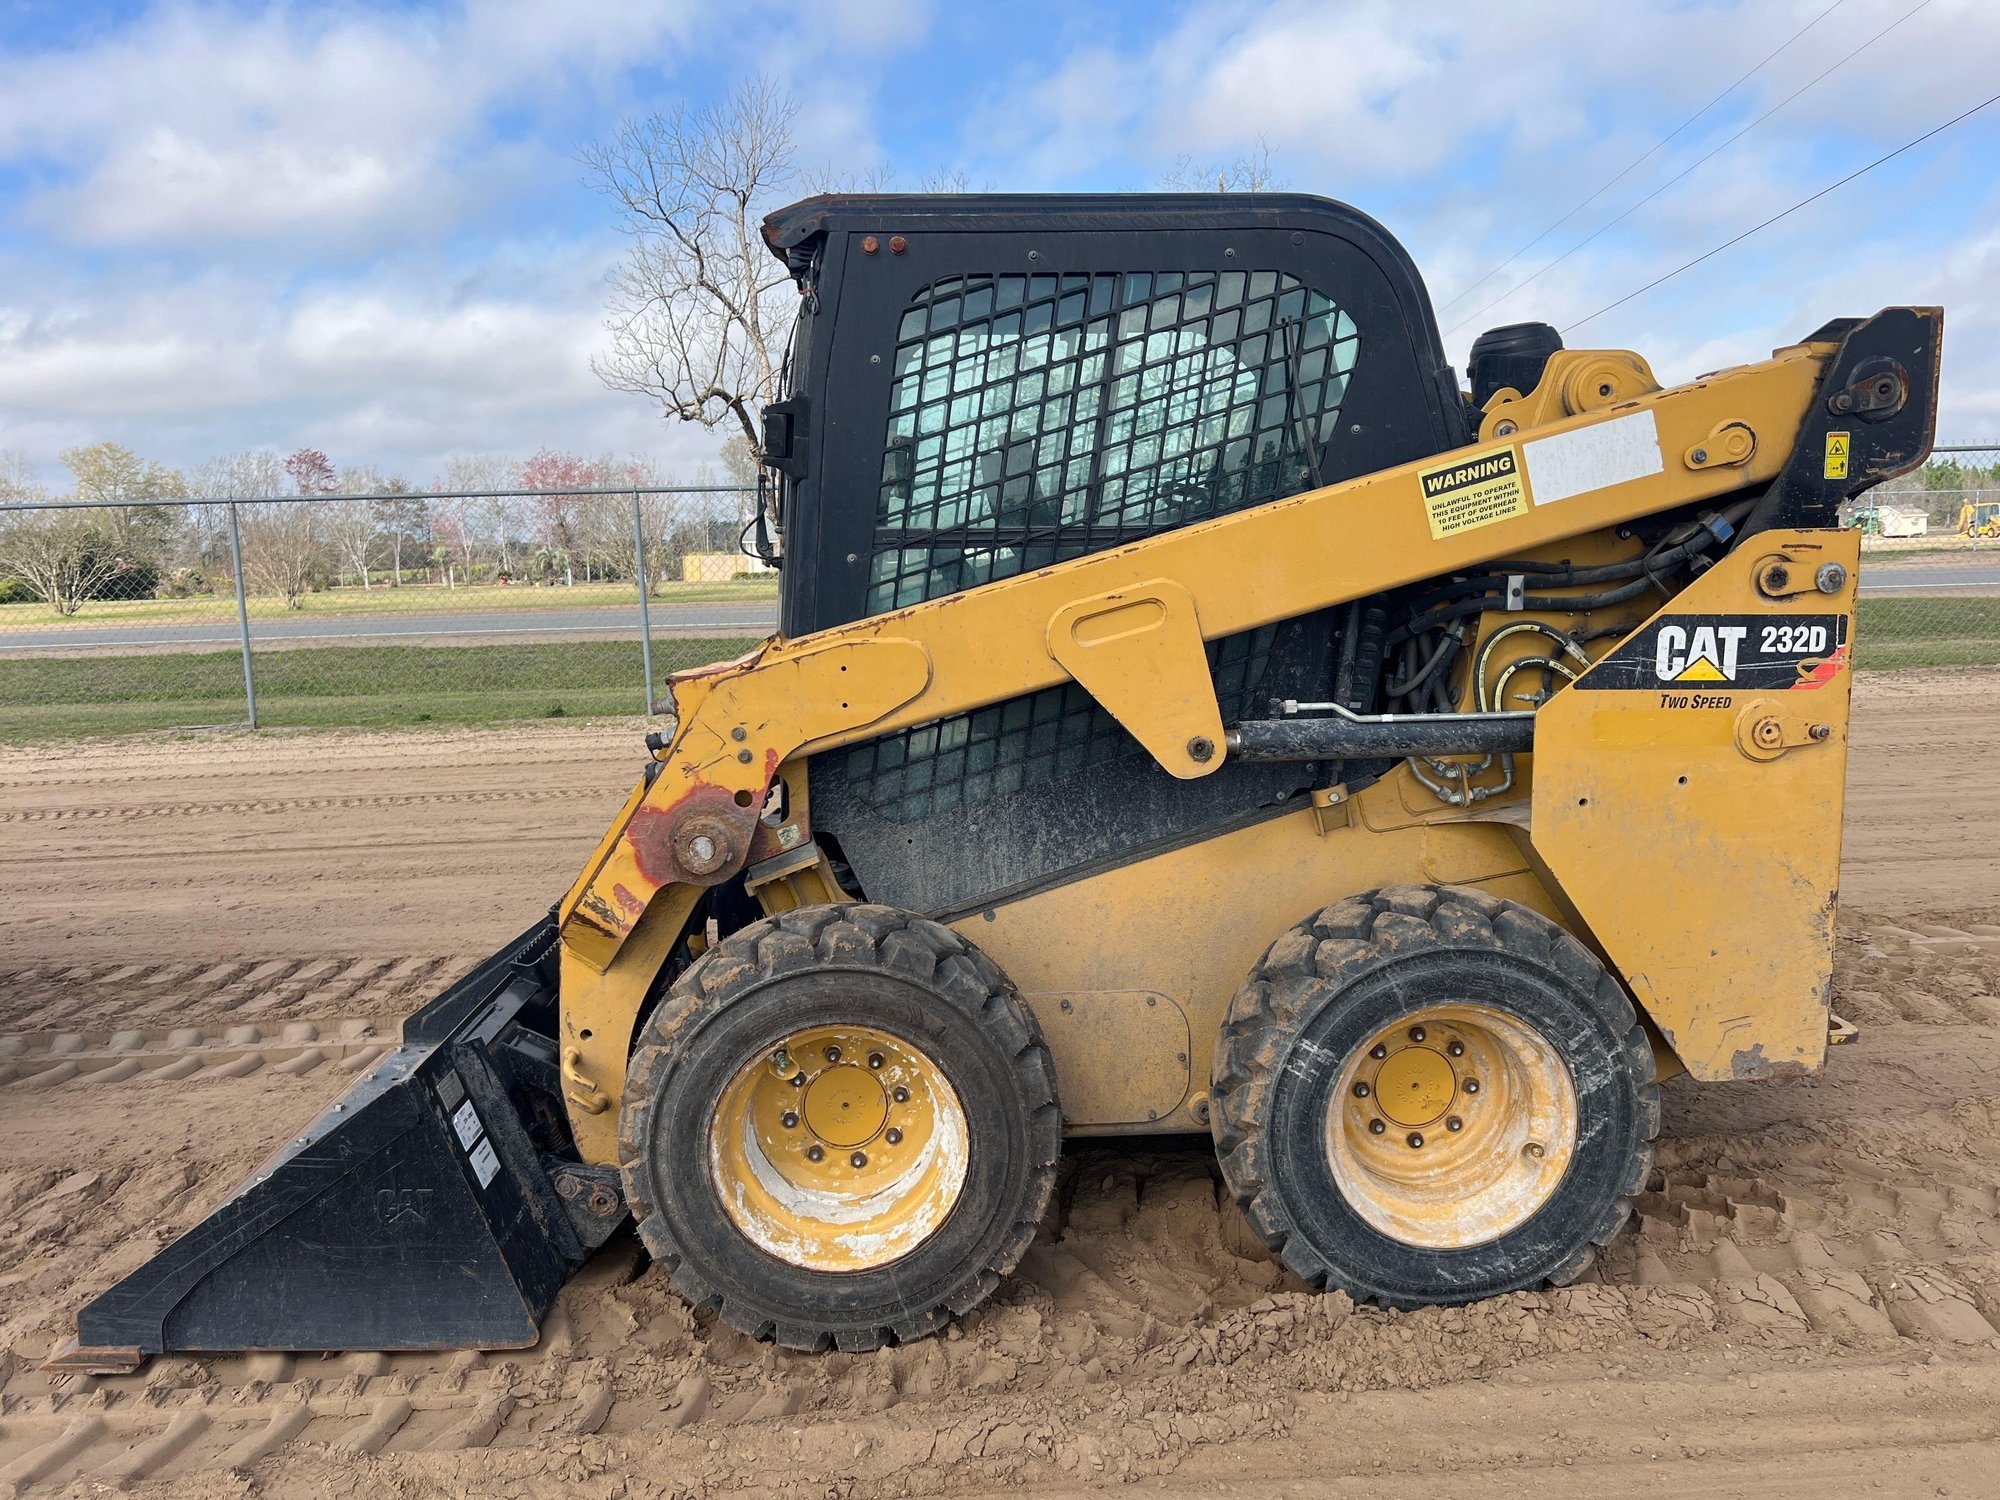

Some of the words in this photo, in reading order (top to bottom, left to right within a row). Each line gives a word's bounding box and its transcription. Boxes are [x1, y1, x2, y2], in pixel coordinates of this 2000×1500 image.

[1427, 457, 1511, 492] WARNING
[1432, 495, 1471, 511] UNLAWFUL
[1473, 491, 1482, 499] TO
[1484, 481, 1516, 495] OPERATE
[1432, 509, 1449, 519] THIS
[1450, 497, 1492, 514] EQUIPMENT
[1494, 488, 1520, 501] WITHIN
[1448, 512, 1466, 522] FEET
[1479, 497, 1517, 513] OVERHEAD
[1442, 522, 1460, 532] HIGH
[1462, 513, 1494, 526] VOLTAGE
[1495, 506, 1516, 516] LINES
[1656, 625, 1747, 681] CAT
[1759, 625, 1827, 653] 232D
